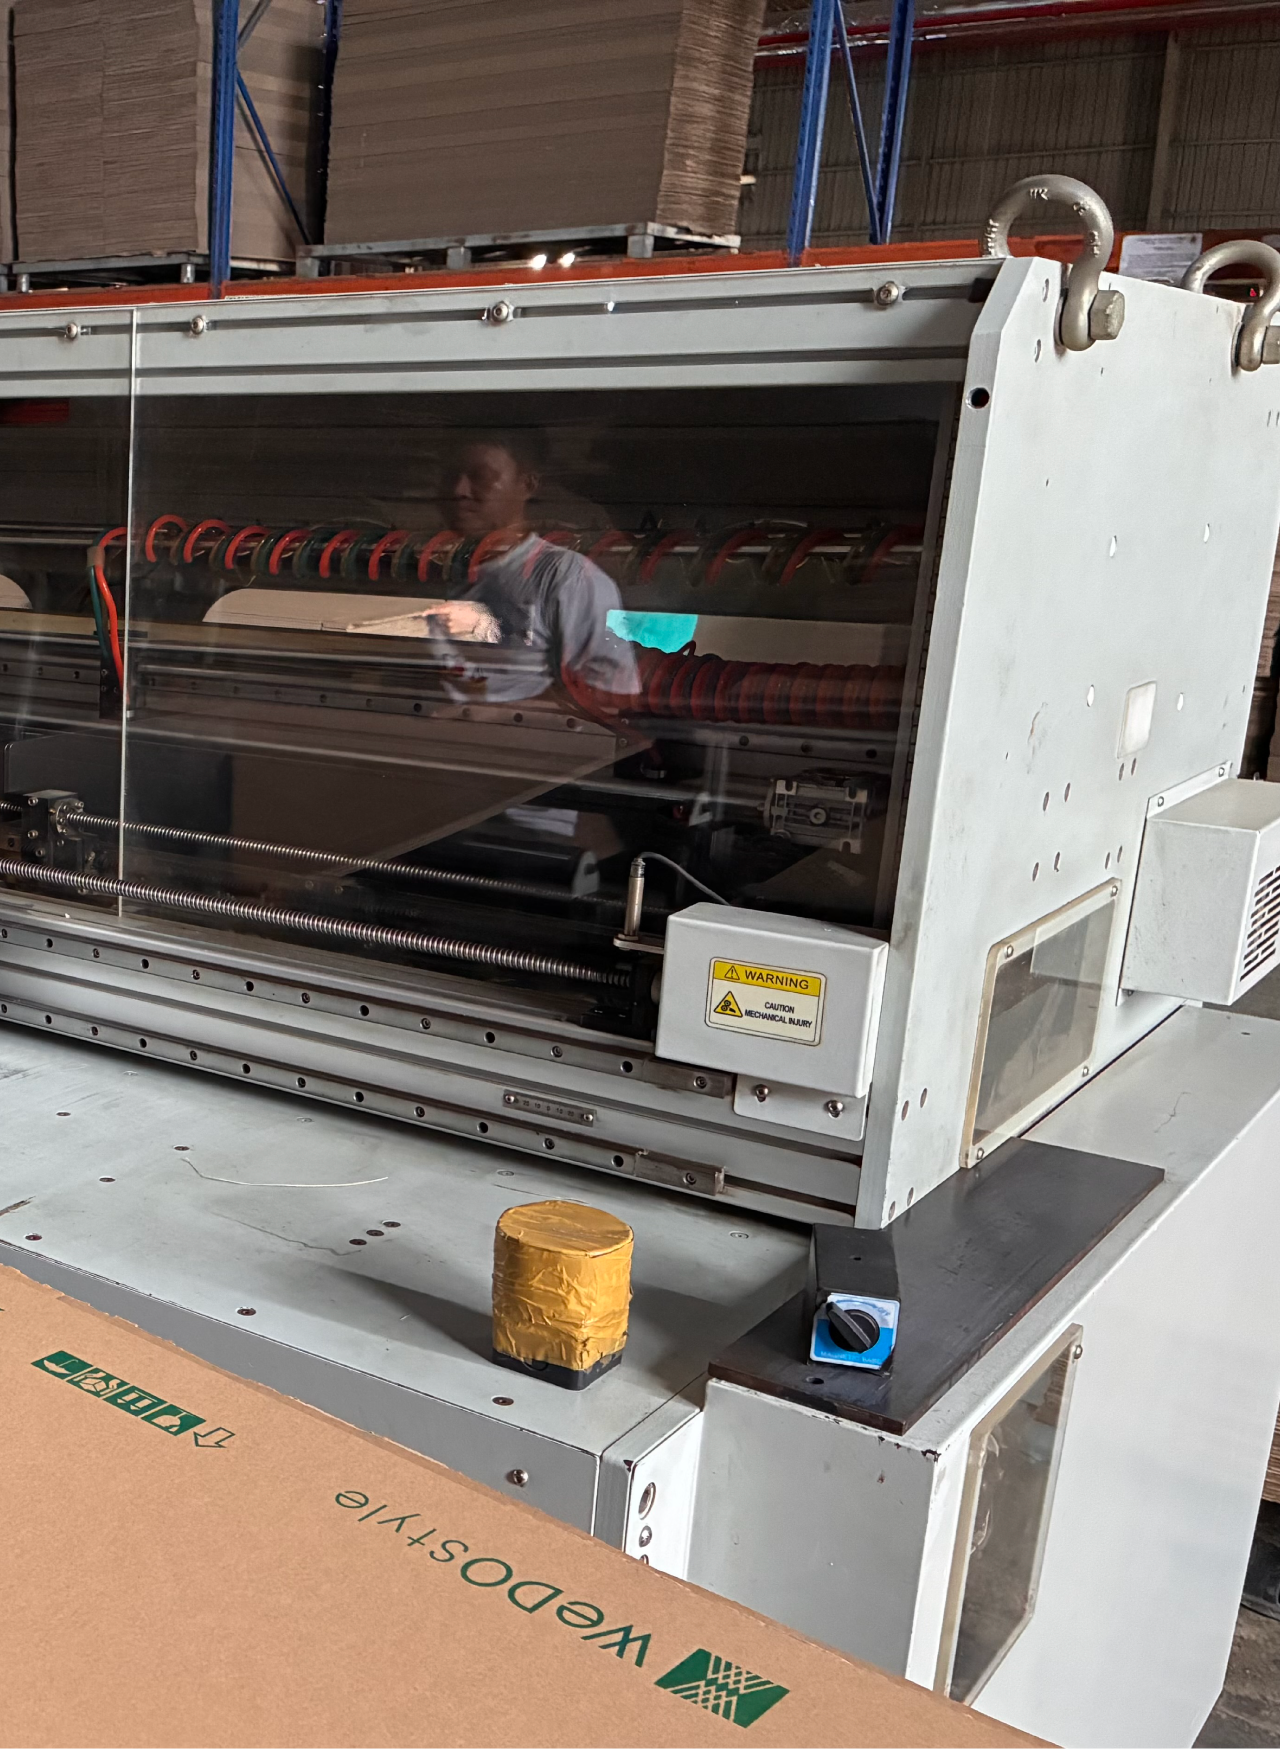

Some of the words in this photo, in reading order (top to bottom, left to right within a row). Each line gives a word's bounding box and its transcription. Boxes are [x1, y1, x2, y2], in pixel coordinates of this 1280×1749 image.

[745, 970, 809, 990] WARNING
[764, 1001, 795, 1014] CAUTION
[744, 1009, 787, 1025] MECHANICAL
[788, 1016, 813, 1029] INJURY
